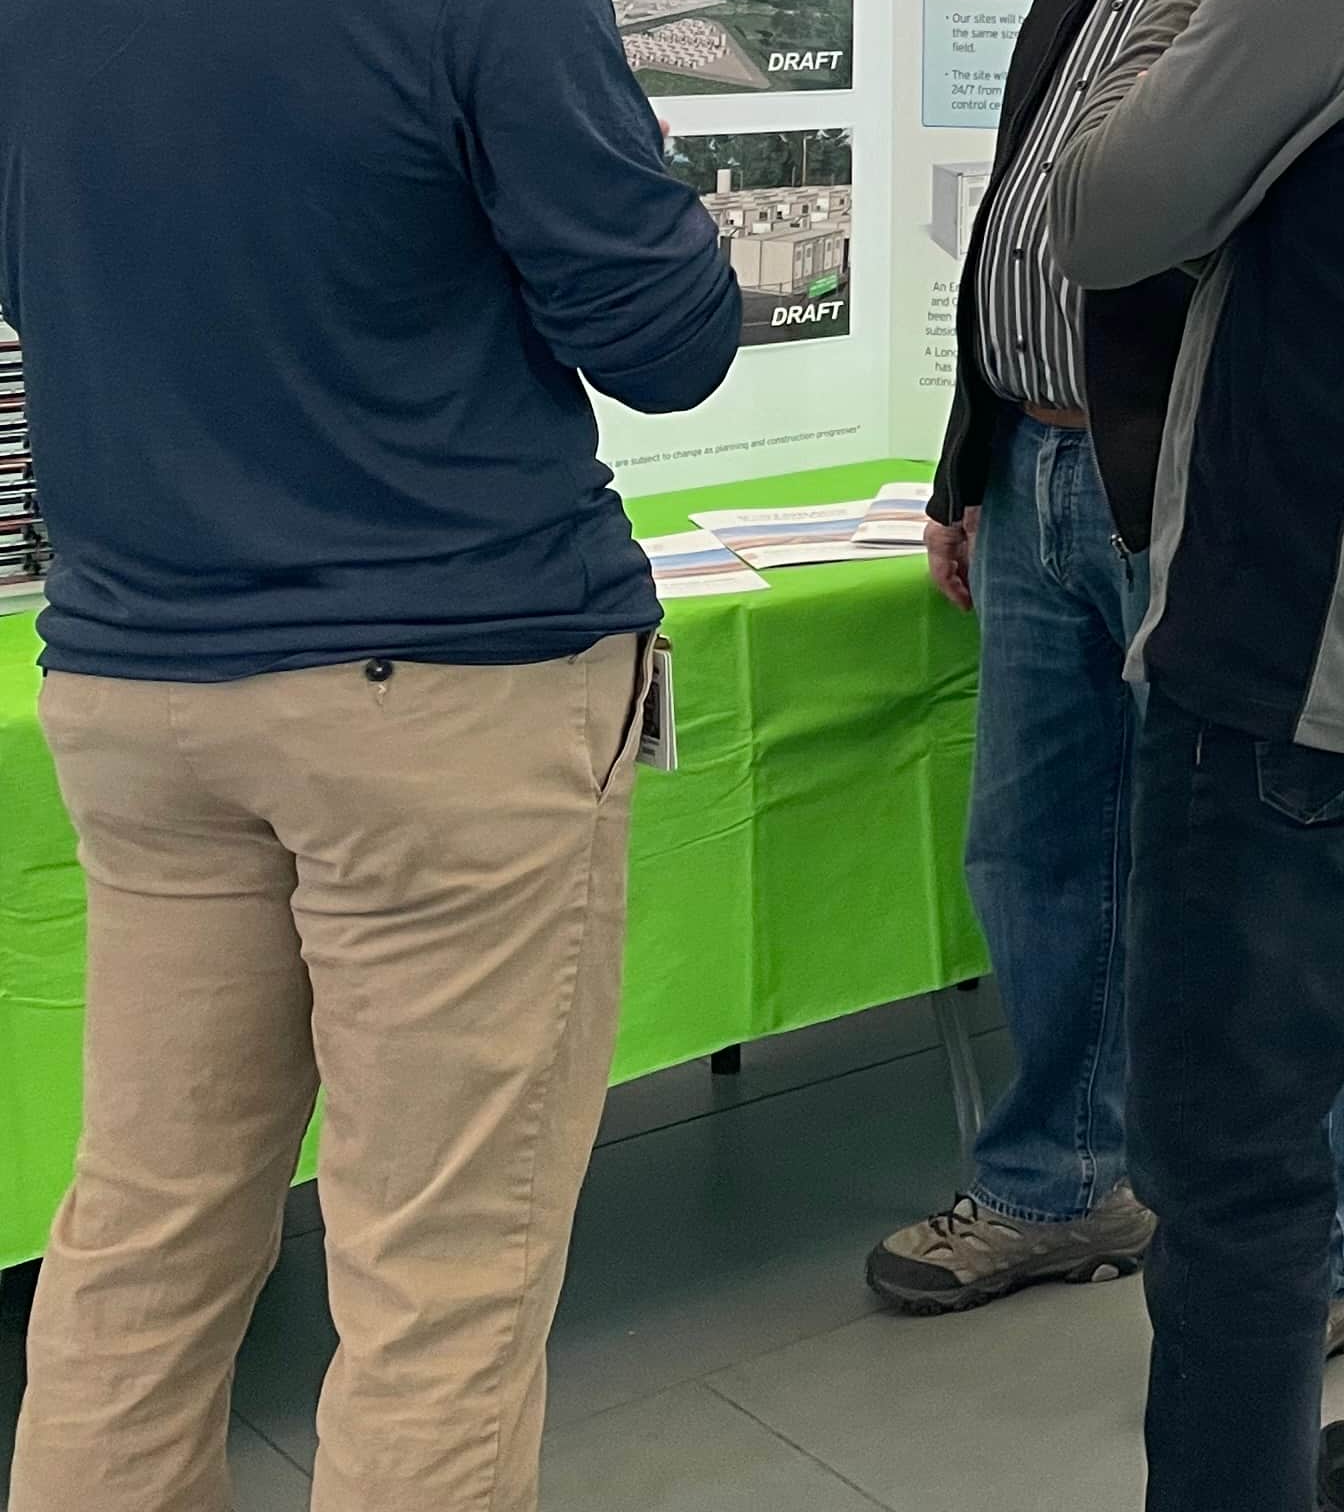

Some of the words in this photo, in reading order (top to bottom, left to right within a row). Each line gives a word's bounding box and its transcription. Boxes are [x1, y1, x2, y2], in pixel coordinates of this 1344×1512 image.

[952, 13, 971, 24] Our
[973, 13, 997, 24] sites
[952, 28, 969, 38] the
[971, 30, 998, 39] same
[767, 50, 843, 72] DRAFT
[952, 69, 970, 81] The
[972, 70, 992, 81] site
[951, 85, 975, 96] 24/7
[977, 85, 1002, 96] from
[951, 98, 987, 110] control
[930, 296, 950, 306] and
[770, 299, 844, 327] DRAFT
